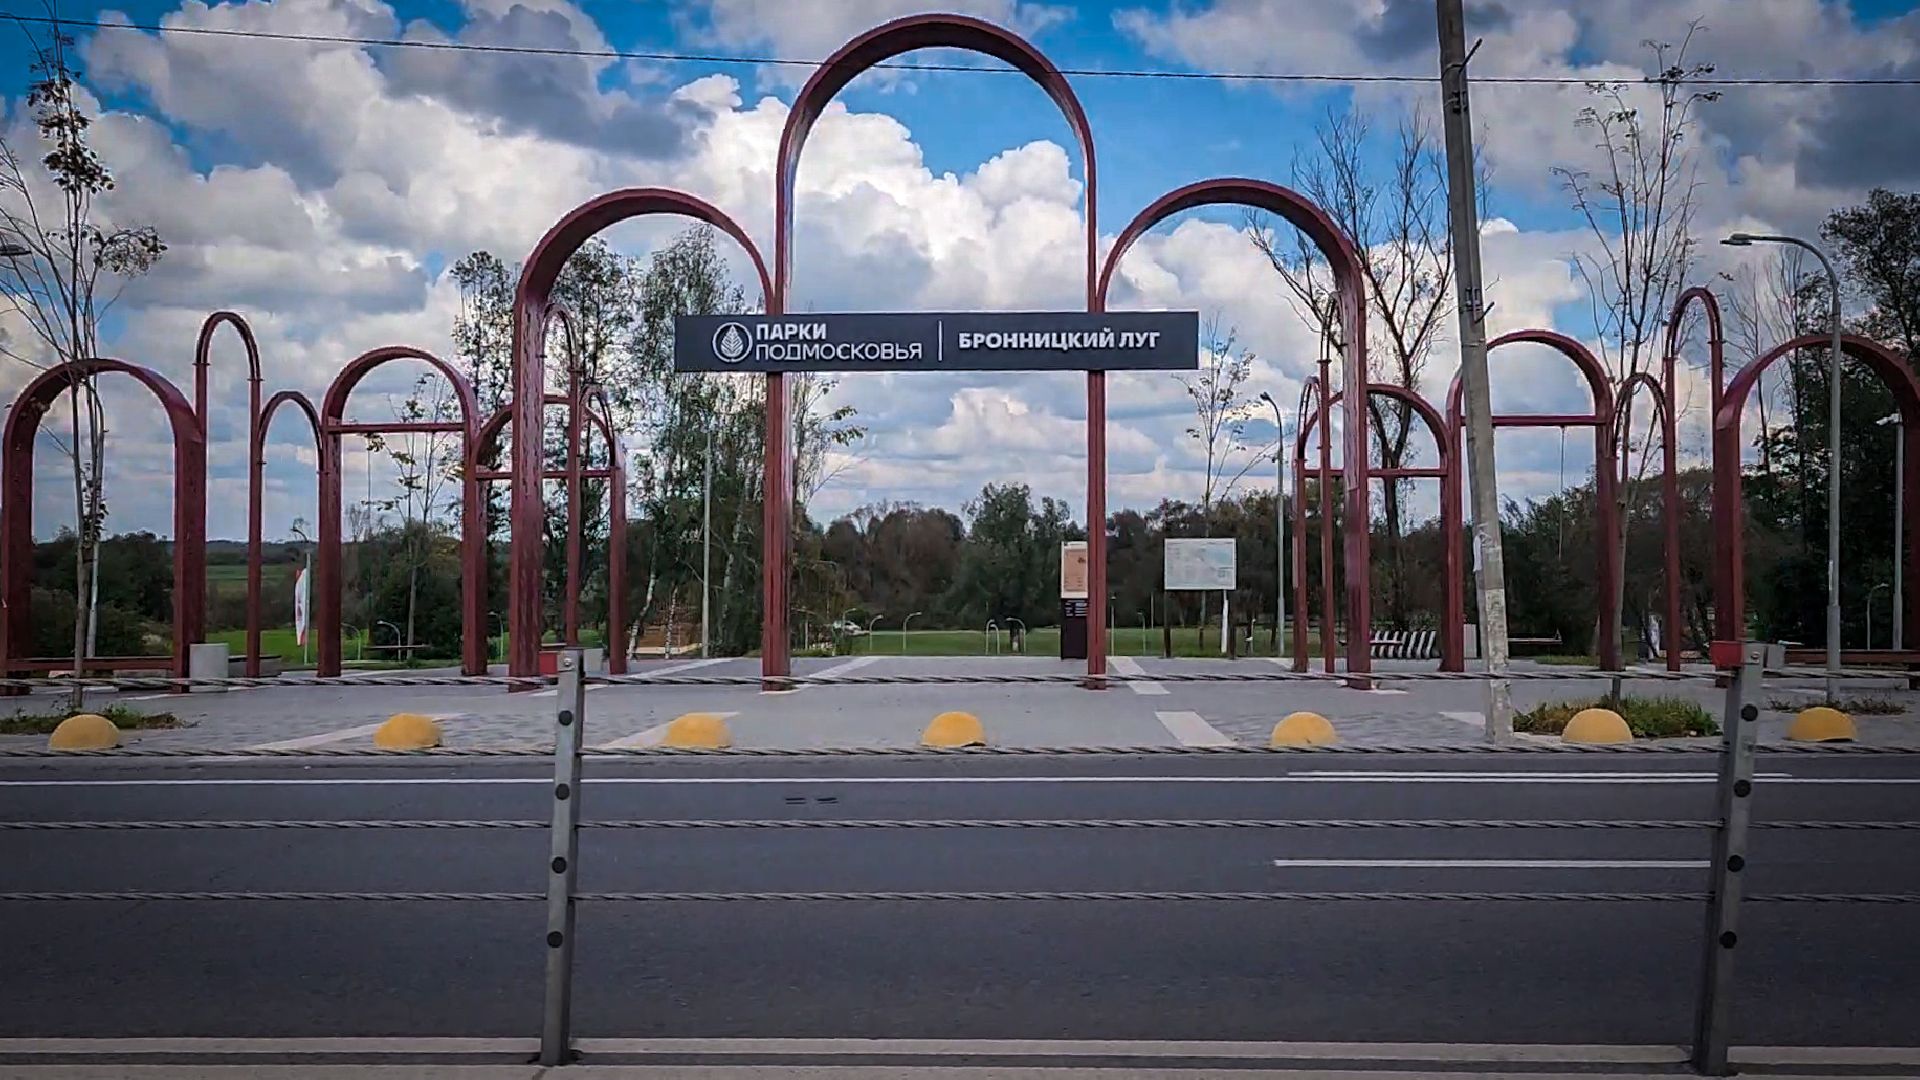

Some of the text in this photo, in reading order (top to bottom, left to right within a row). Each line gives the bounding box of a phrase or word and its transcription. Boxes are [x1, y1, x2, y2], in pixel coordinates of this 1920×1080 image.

[756, 322, 827, 341] ПАРКИ
[958, 327, 1161, 351] БРОННИЦКИЙ ЛУГ
[756, 342, 923, 361] ПОДМОСКОВЬЯ
